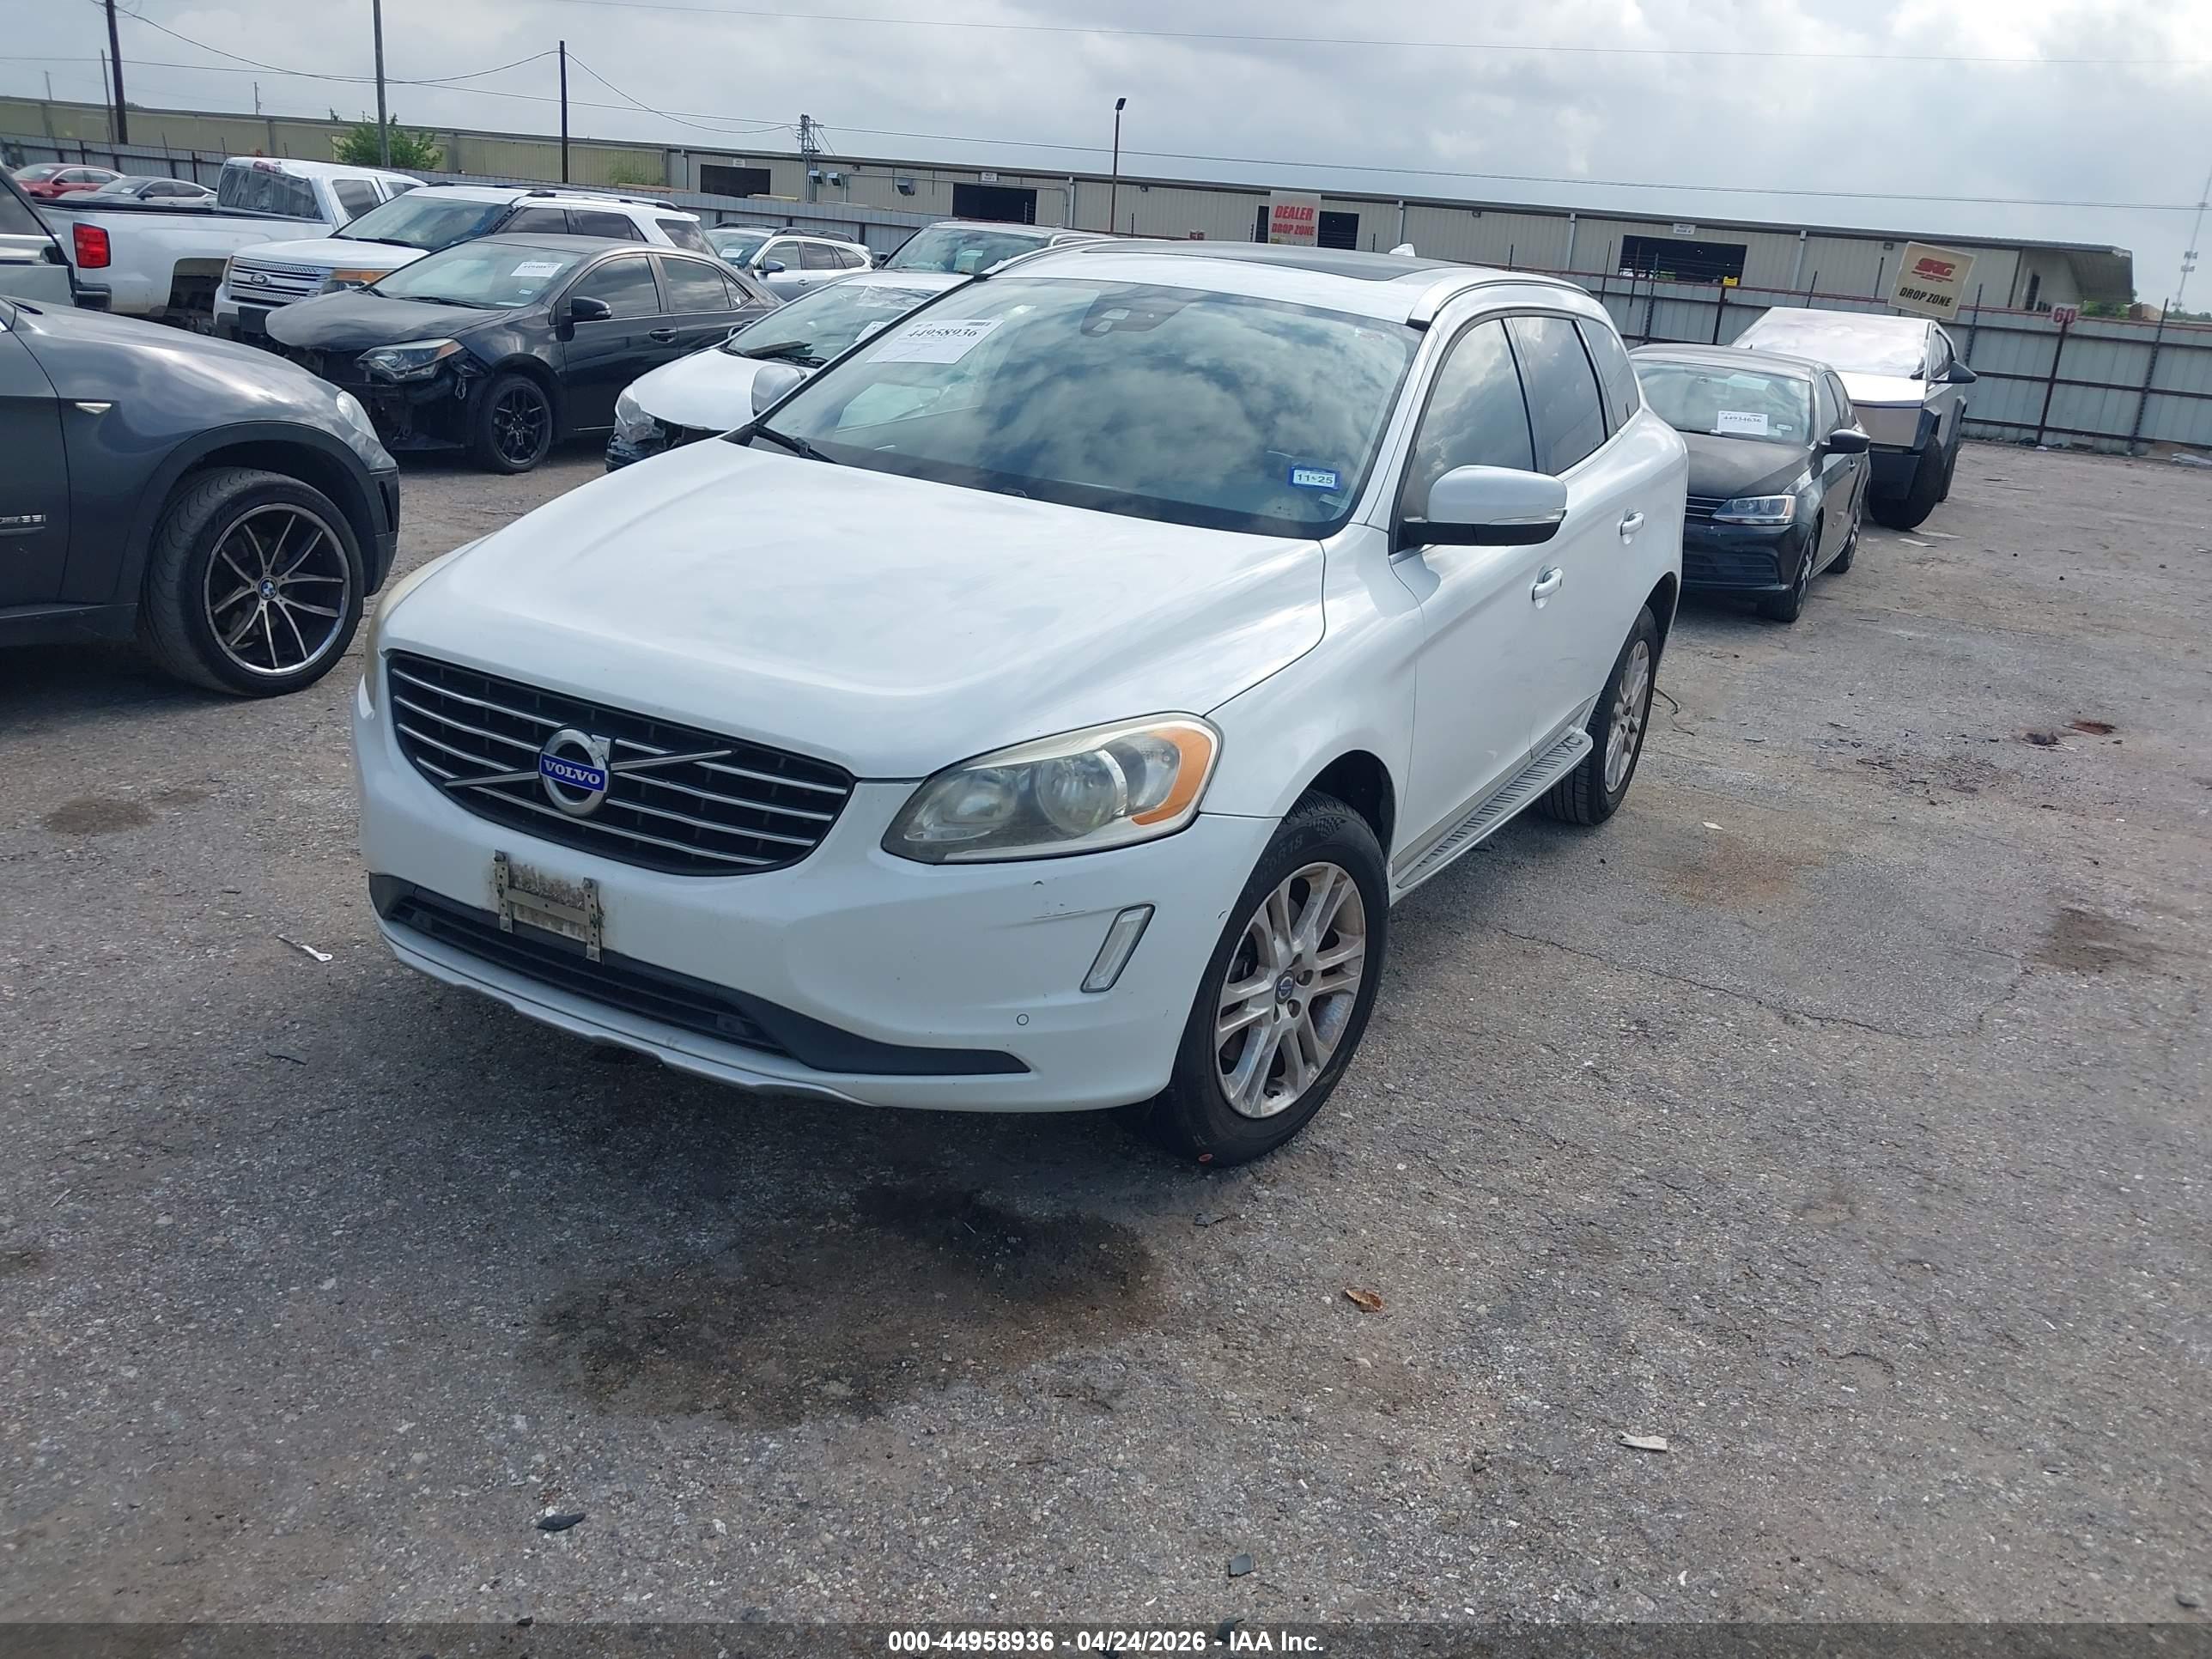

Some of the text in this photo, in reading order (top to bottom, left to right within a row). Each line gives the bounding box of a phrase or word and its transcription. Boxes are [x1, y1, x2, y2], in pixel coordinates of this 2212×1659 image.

[1274, 205, 1314, 221] DEALER
[1272, 223, 1315, 235] DROP ZONE
[1899, 288, 1953, 307] DROP ZONE
[2053, 307, 2075, 325] 60
[907, 328, 978, 337] 44958936
[544, 759, 600, 785] VOLVO
